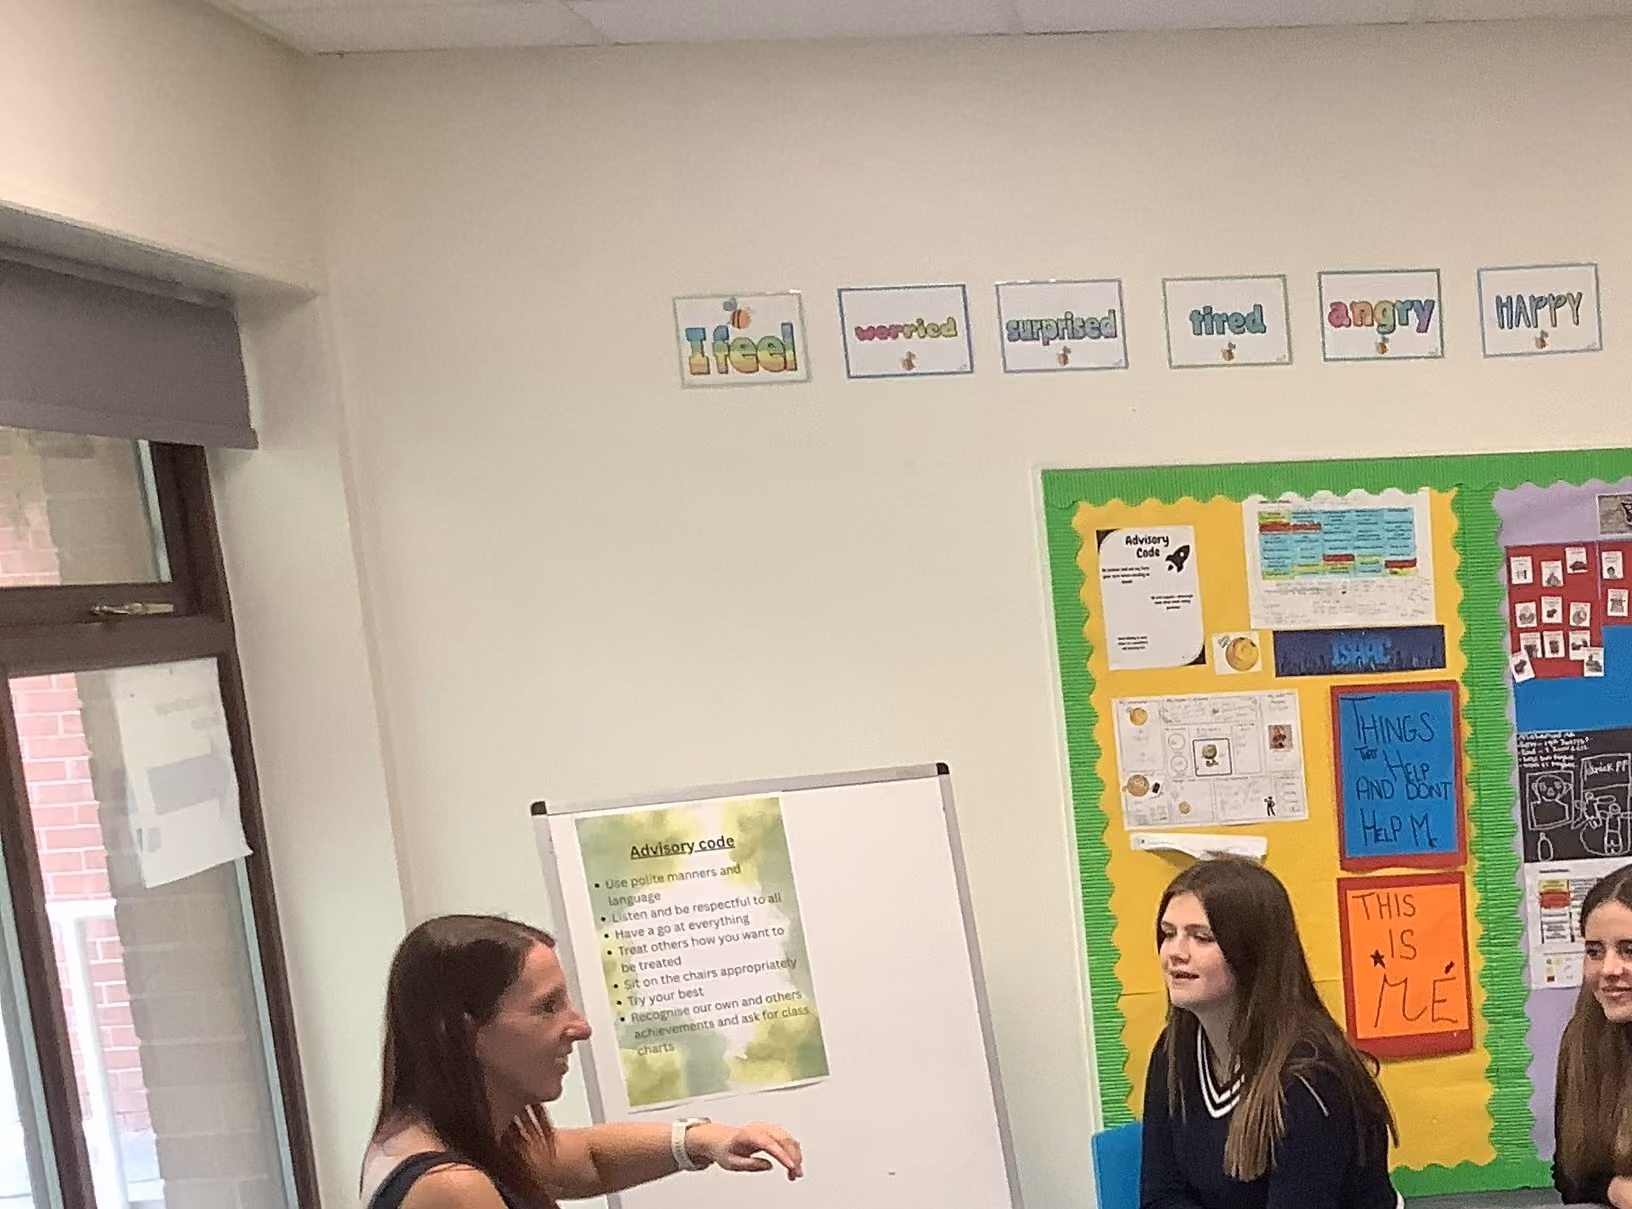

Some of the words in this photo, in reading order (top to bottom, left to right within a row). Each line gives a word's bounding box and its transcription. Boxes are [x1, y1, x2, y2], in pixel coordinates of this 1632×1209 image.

[1190, 303, 1266, 336] tired
[1327, 299, 1435, 334] angry
[1495, 291, 1582, 329] HAPPY
[854, 316, 958, 341] worried
[1006, 309, 1117, 346] surprised
[685, 327, 711, 376] I
[712, 322, 798, 374] feel
[1125, 535, 1169, 547] Advisory
[1136, 547, 1160, 558] Code
[1356, 776, 1395, 800] AND
[631, 841, 695, 858] Advisory
[699, 835, 735, 851] code
[605, 879, 628, 889] Use
[631, 874, 664, 888] polite
[667, 868, 717, 881] manners
[720, 864, 741, 875] and
[608, 892, 661, 906] language
[611, 910, 647, 923] Listen
[650, 906, 672, 918] and
[675, 905, 689, 915] be
[692, 897, 751, 912] respectful
[753, 896, 765, 905] to
[768, 892, 782, 903] all
[1352, 892, 1416, 920] THIS
[615, 928, 645, 939] Have
[657, 925, 671, 936] go
[674, 922, 686, 932] at
[689, 914, 750, 930] everything
[618, 944, 648, 956] Treat
[651, 939, 689, 952] others
[691, 936, 716, 946] how
[718, 934, 739, 946] you
[742, 929, 769, 940] want
[772, 927, 784, 936] to
[1388, 929, 1417, 960] IS
[621, 963, 636, 973] be
[638, 956, 682, 970] treated
[624, 979, 640, 990] Sit
[643, 978, 658, 987] on
[661, 974, 680, 984] the
[682, 970, 718, 982] chairs
[720, 958, 797, 977] appropriately
[627, 995, 646, 1007] Try
[649, 992, 675, 1006] your
[678, 987, 704, 999] best
[631, 1007, 690, 1022] Recognise
[693, 1003, 712, 1013] our
[715, 1000, 739, 1010] own
[741, 995, 763, 1007] and
[765, 990, 802, 1003] others
[634, 1020, 715, 1040] achievements
[717, 1014, 739, 1027] and
[741, 1012, 760, 1024] ask
[762, 1010, 778, 1020] for
[781, 1005, 810, 1018] class
[637, 1042, 675, 1056] charts
